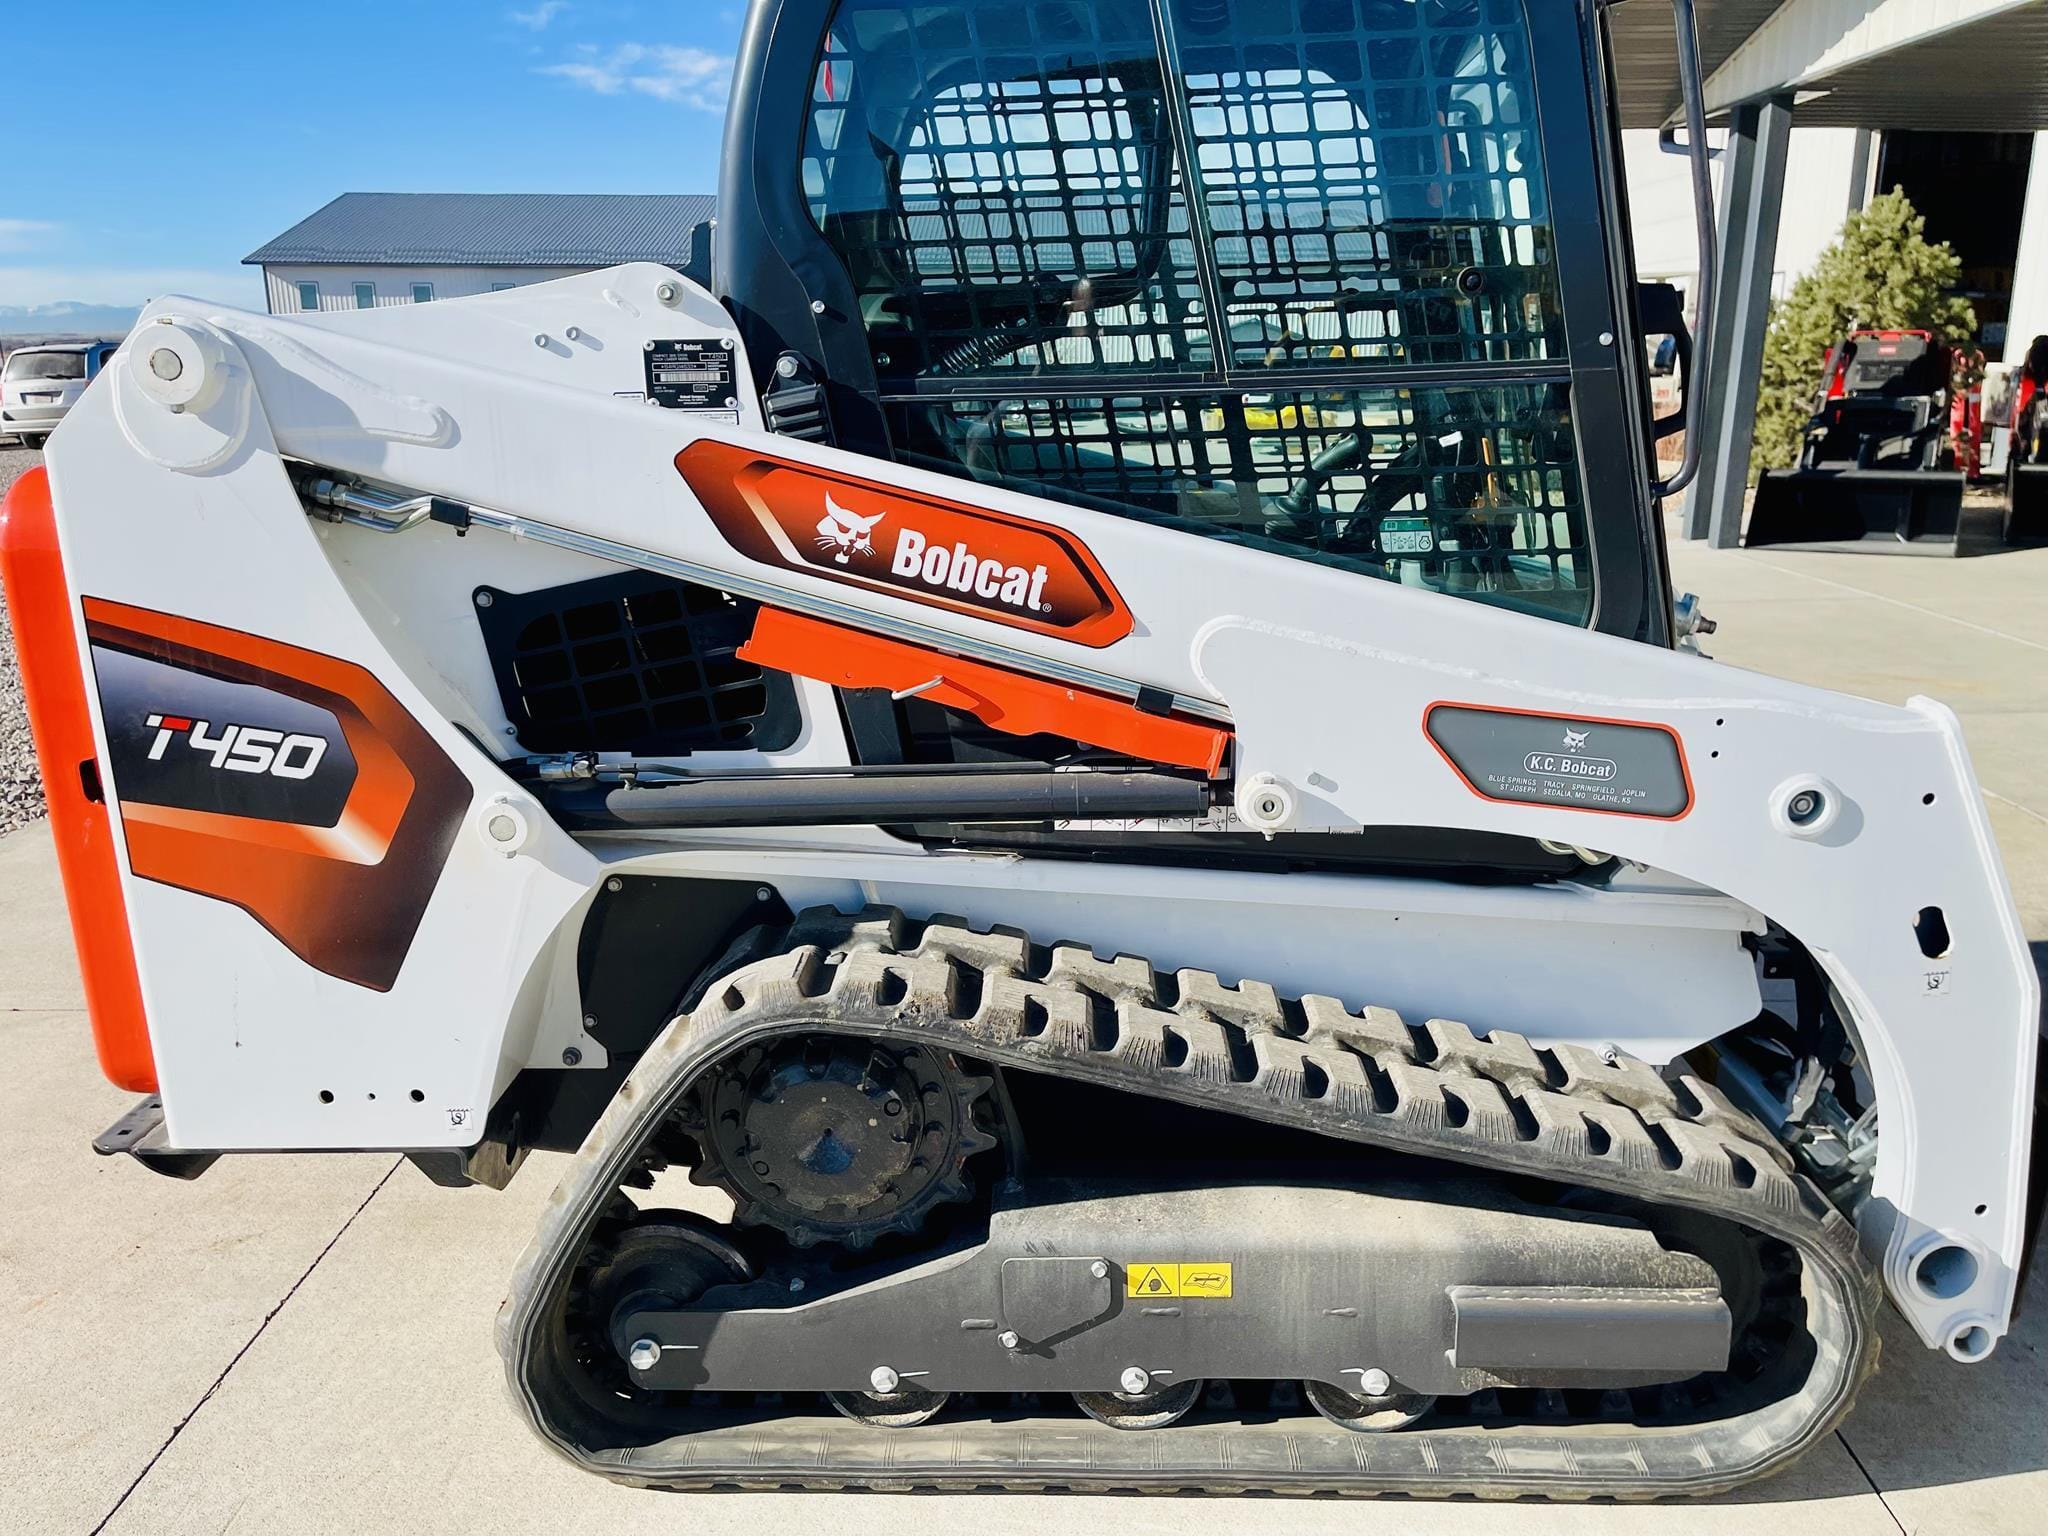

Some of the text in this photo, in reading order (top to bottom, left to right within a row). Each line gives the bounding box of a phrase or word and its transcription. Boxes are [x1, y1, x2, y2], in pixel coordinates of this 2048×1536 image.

[891, 527, 1048, 611] Bobcat
[145, 714, 328, 780] T450
[1530, 755, 1612, 777] K.C. Bobcat
[1488, 774, 1646, 798] BLUE SPRINGS TRACY SPRINGFIELD JOPLIN
[1500, 783, 1632, 804] ST JOSEPH SEDALIA, MO OLATHE, KS
